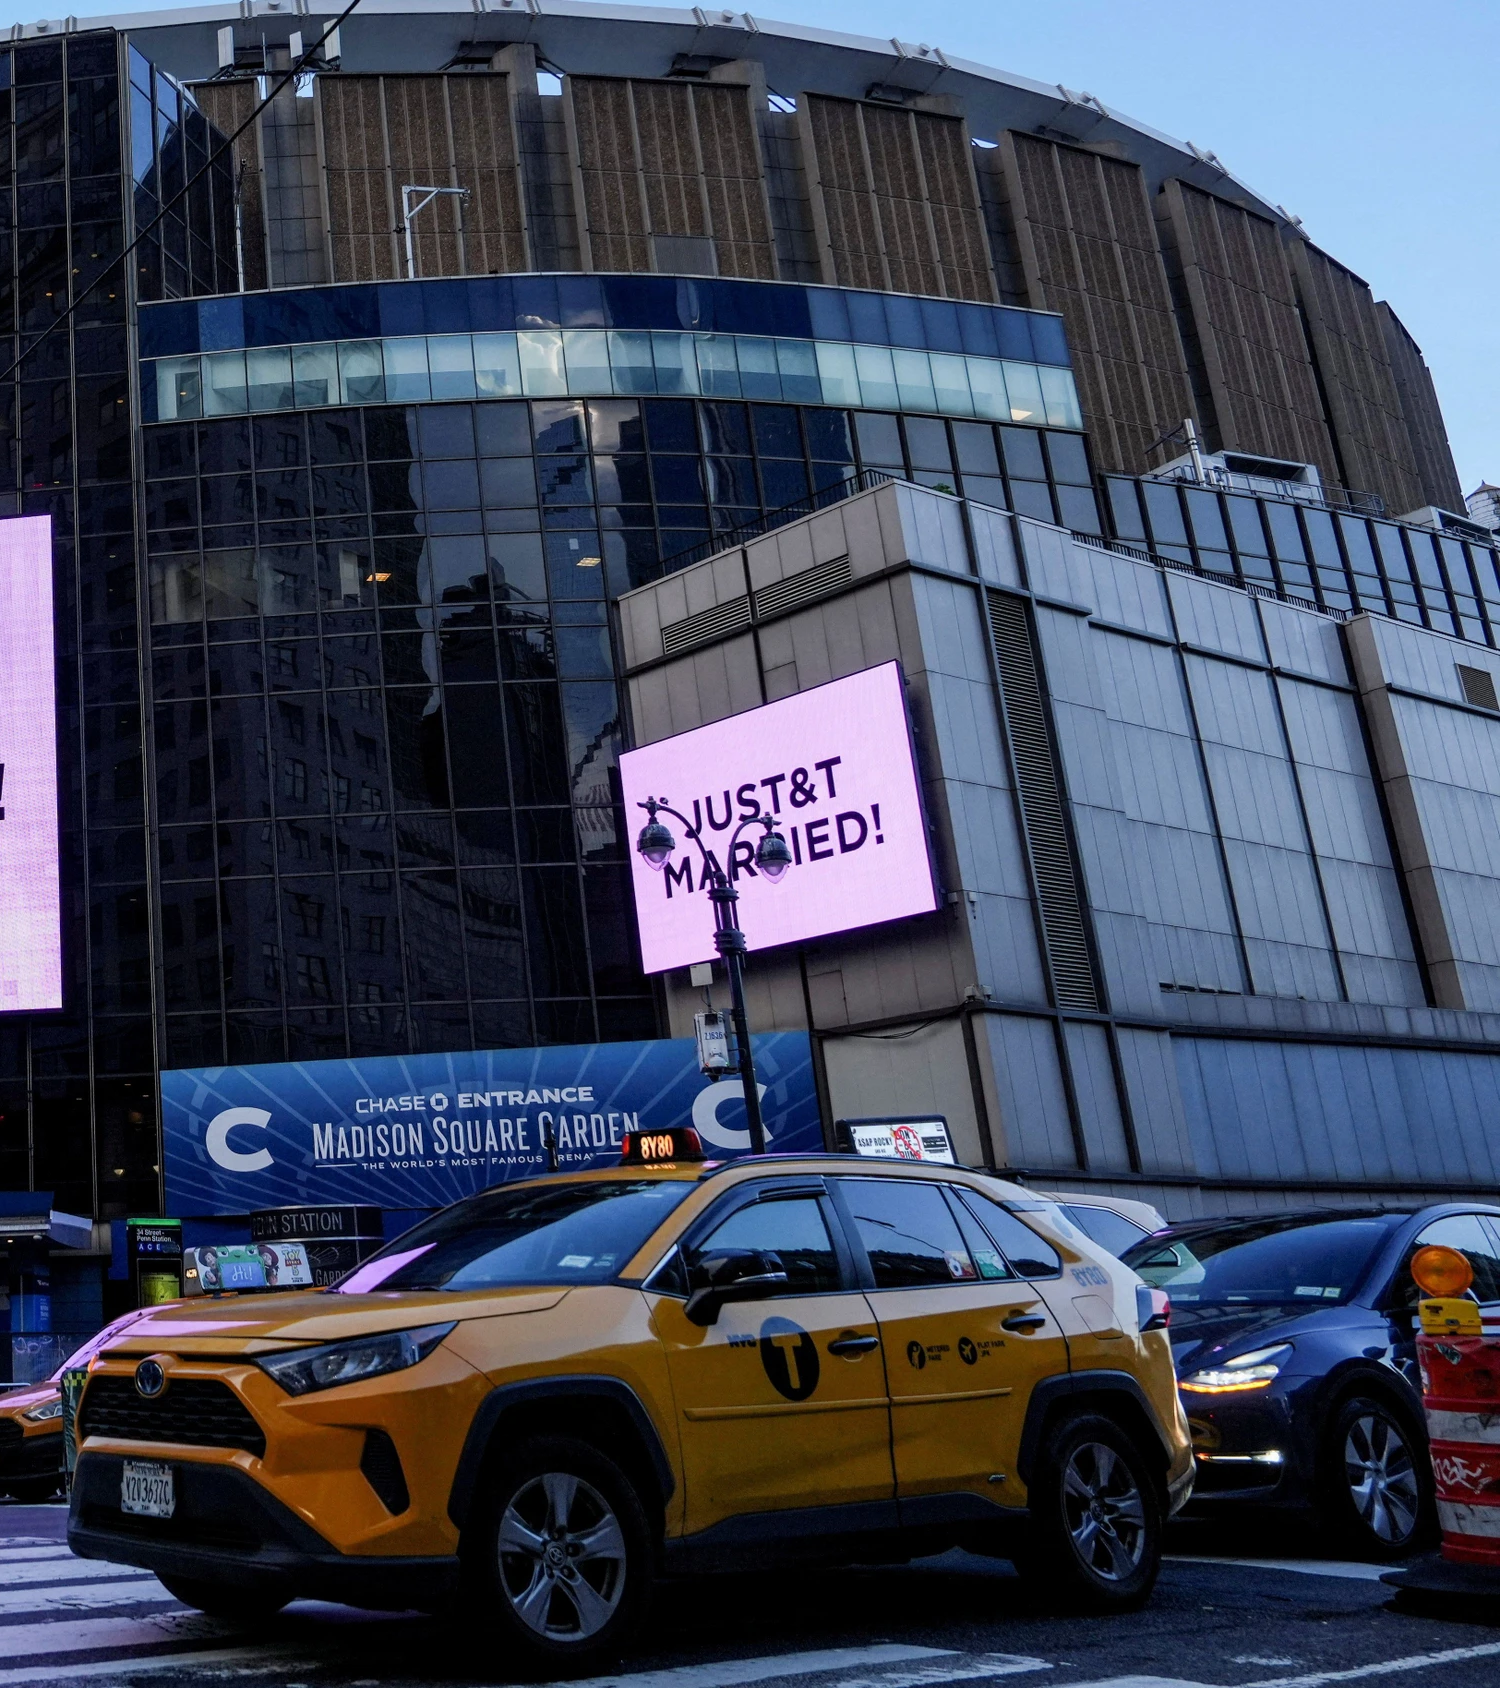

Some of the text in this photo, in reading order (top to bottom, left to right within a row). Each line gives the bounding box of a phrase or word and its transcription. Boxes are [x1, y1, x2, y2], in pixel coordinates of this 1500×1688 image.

[685, 756, 841, 839] JUST&T
[663, 803, 884, 899] MARIED!
[355, 1086, 595, 1114] CHASE ENTRANCE
[691, 1079, 774, 1150] C
[205, 1106, 276, 1173] C
[313, 1111, 639, 1160] MADISON SQUARE GARDEN
[640, 1134, 674, 1159] 8Y80
[362, 1162, 385, 1170] THE
[390, 1159, 446, 1169] WORLD'S
[451, 1157, 486, 1167] MOST
[492, 1155, 543, 1165] FAMOUS
[281, 1211, 343, 1233] STATION
[232, 1265, 253, 1281] Hi!
